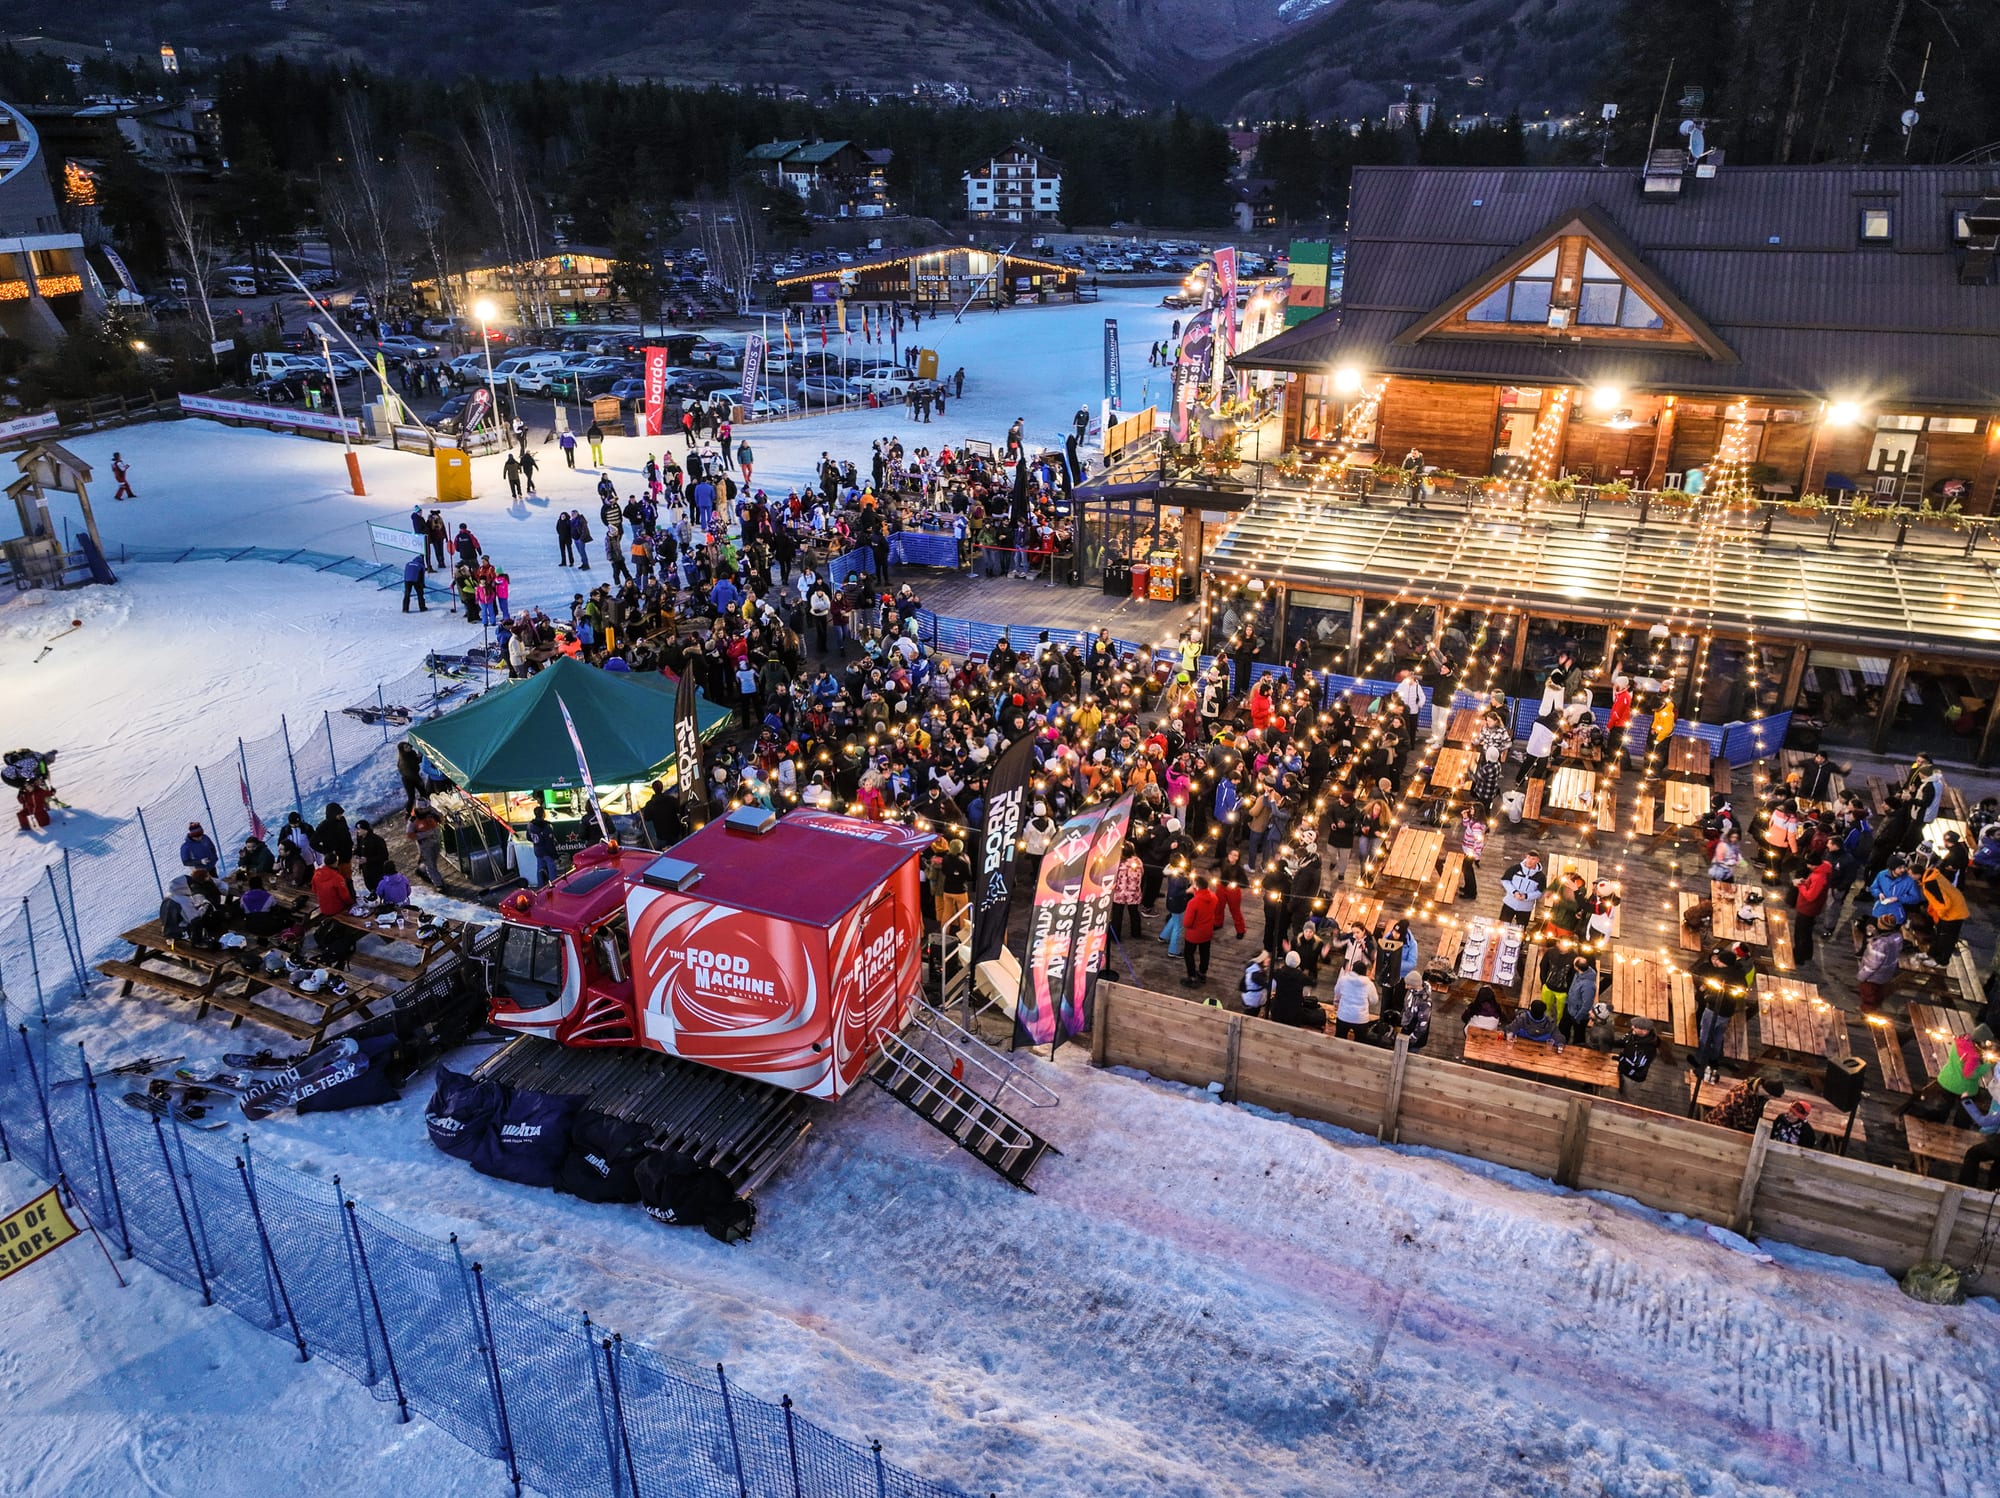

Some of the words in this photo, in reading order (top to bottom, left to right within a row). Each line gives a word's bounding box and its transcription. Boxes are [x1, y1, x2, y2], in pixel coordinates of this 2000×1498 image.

[649, 354, 664, 405] bardo.
[743, 351, 758, 397] HARALD'S
[1176, 361, 1190, 402] HARALD'S
[1190, 354, 1202, 373] SKI
[675, 720, 693, 792] BORN
[984, 792, 1008, 874] BORN
[1058, 884, 1081, 917] SKI
[1030, 899, 1056, 968] HARALD'S
[669, 950, 686, 960] THE
[686, 947, 750, 974] FOOD
[695, 966, 775, 997] MACHINE
[24, 1203, 47, 1229] OF
[0, 1226, 57, 1271] SLOPE
